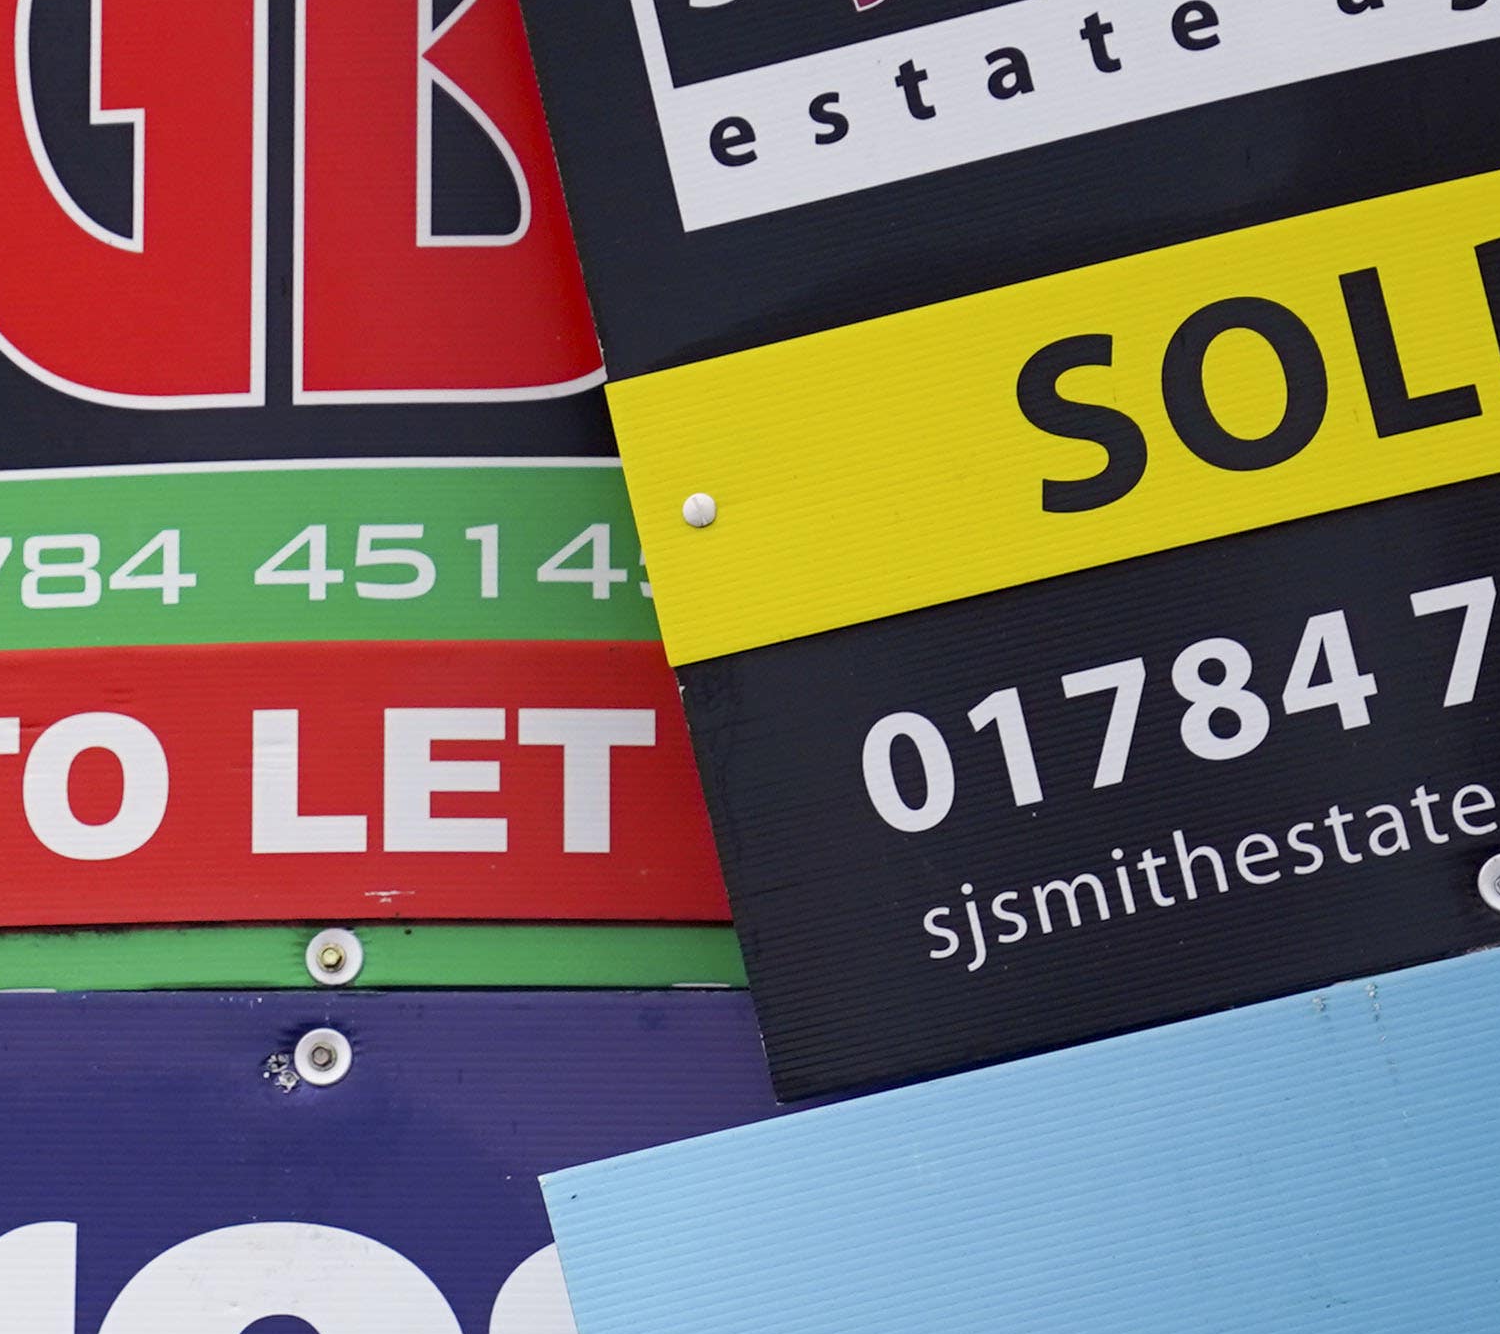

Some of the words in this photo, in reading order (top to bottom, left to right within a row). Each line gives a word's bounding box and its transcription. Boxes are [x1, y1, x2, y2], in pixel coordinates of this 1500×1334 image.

[710, 1, 1219, 166] estate
[254, 523, 652, 601] 4514
[250, 707, 656, 855] LET
[863, 610, 1378, 833] 01784
